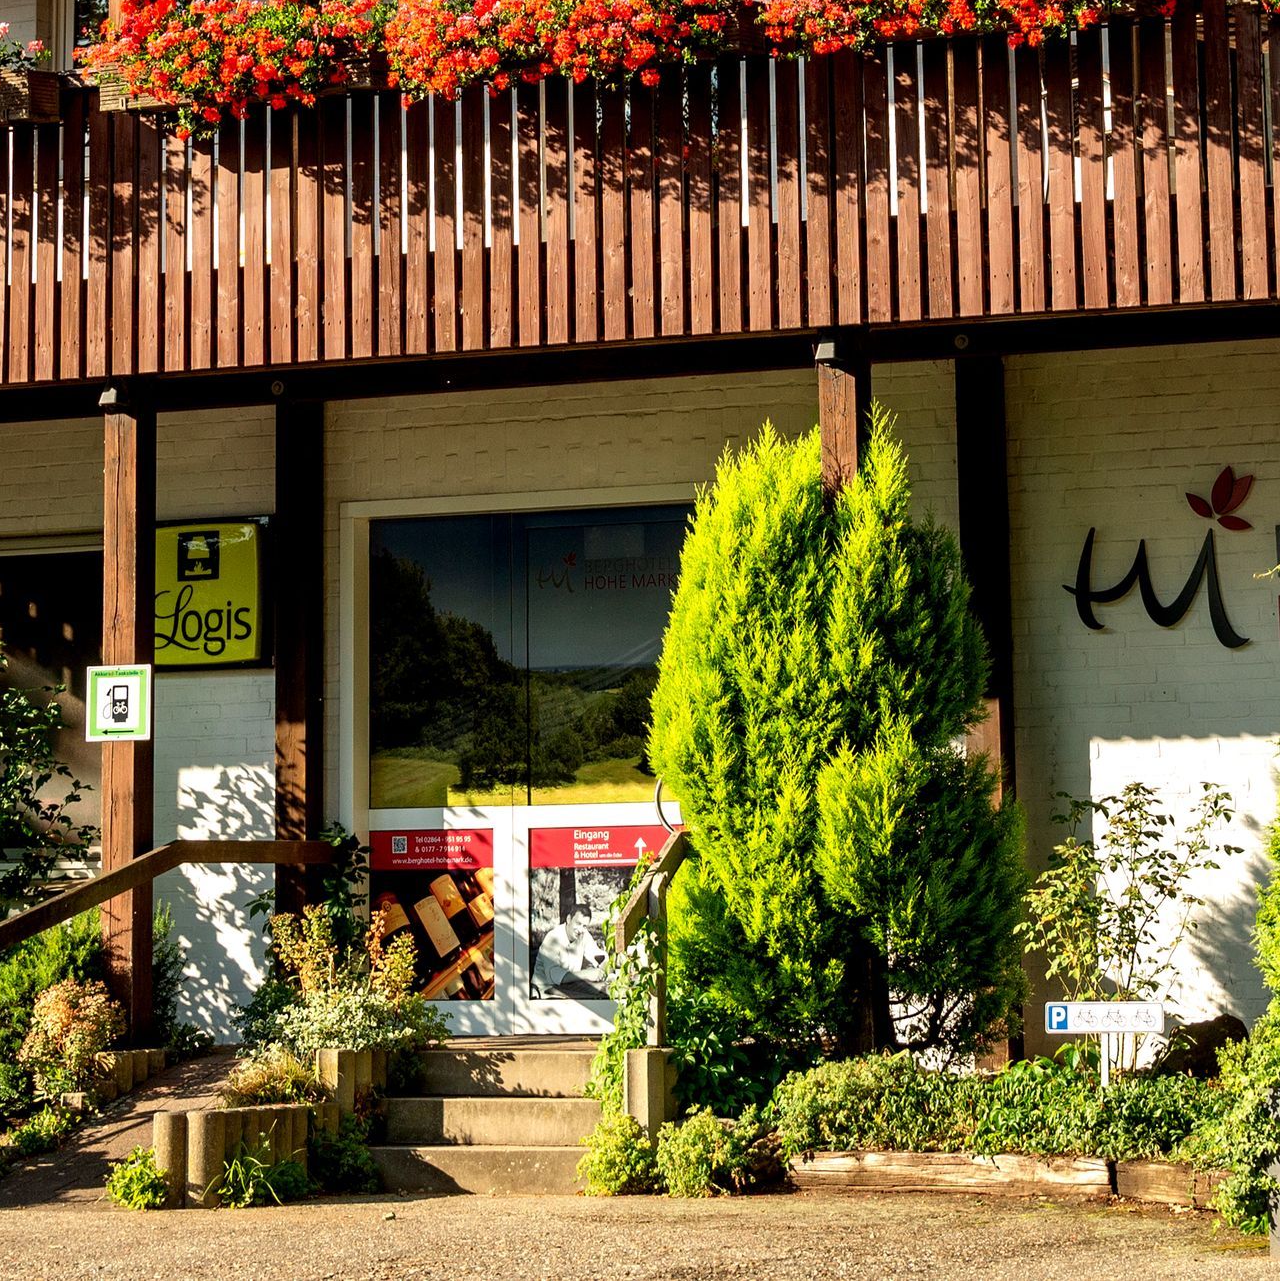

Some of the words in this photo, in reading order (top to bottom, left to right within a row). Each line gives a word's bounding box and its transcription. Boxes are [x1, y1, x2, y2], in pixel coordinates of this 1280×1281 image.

[584, 575, 626, 590] HOHE
[631, 573, 678, 588] MARK
[155, 584, 252, 656] Logis
[573, 829, 610, 842] Eingang
[573, 842, 609, 850] Restaurant
[1051, 1006, 1066, 1029] P
